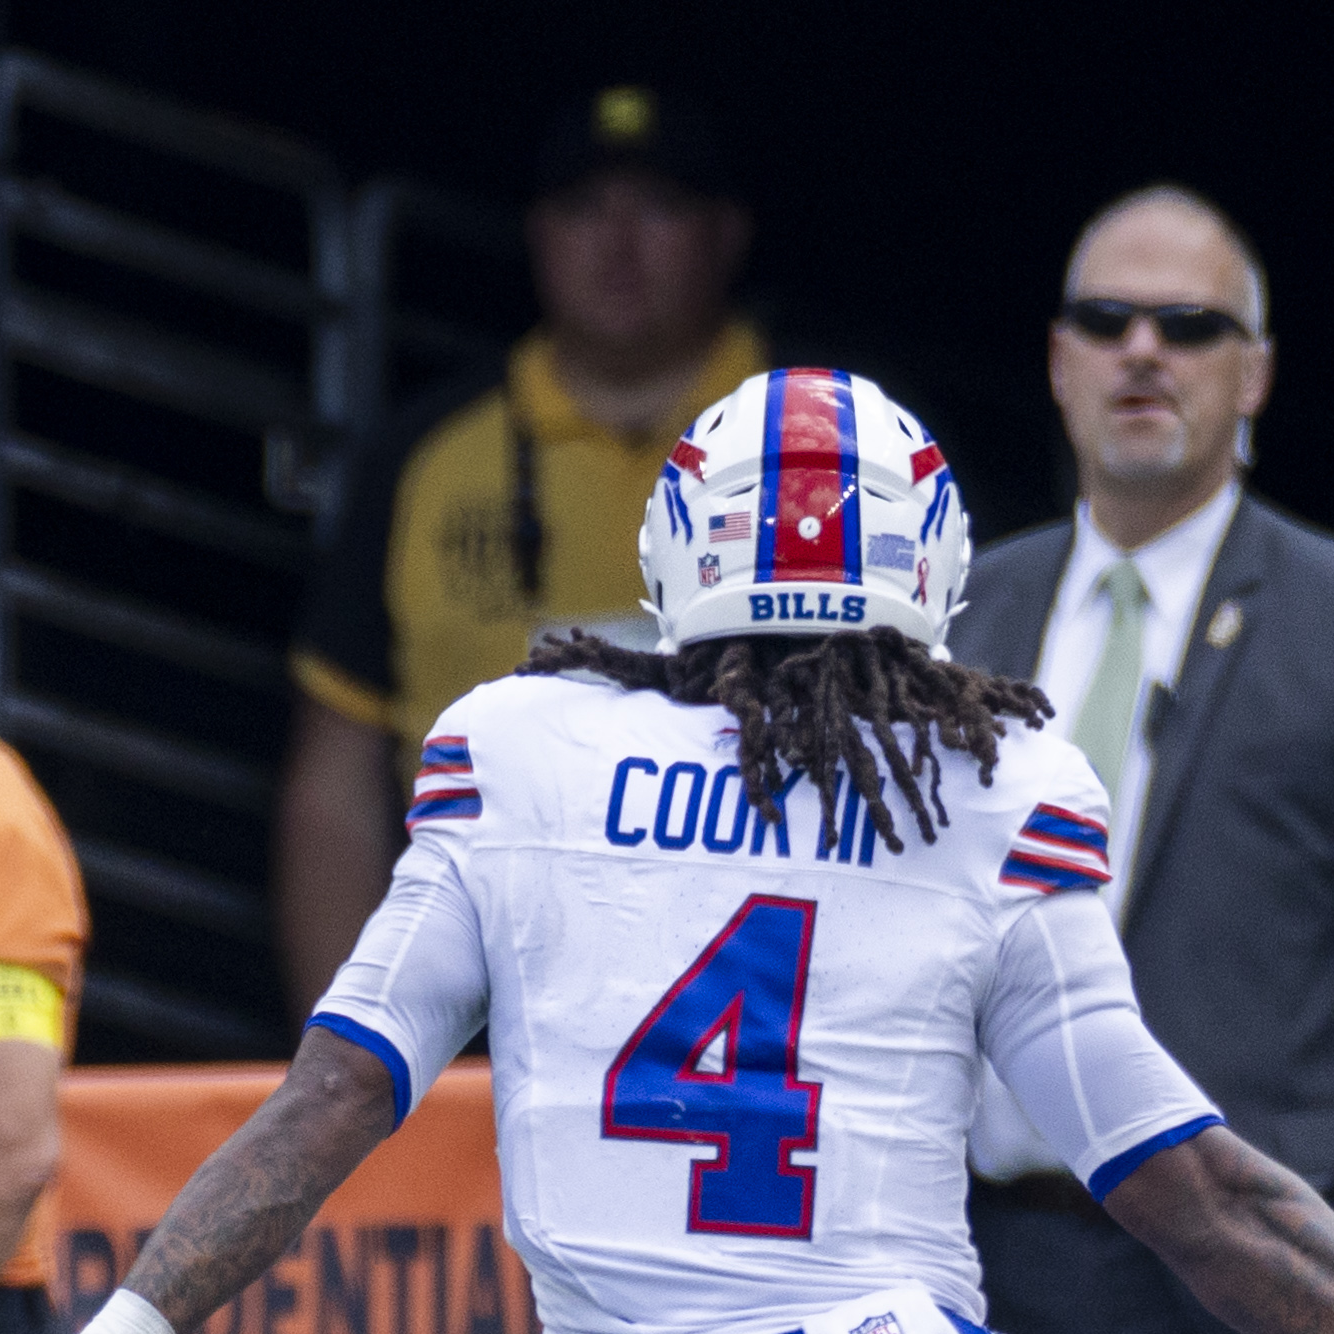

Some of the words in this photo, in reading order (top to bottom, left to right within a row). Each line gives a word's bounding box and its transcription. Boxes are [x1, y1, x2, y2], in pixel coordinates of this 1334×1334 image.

[748, 592, 867, 623] BILLS
[604, 756, 806, 858] COOK
[599, 892, 823, 1242] 4
